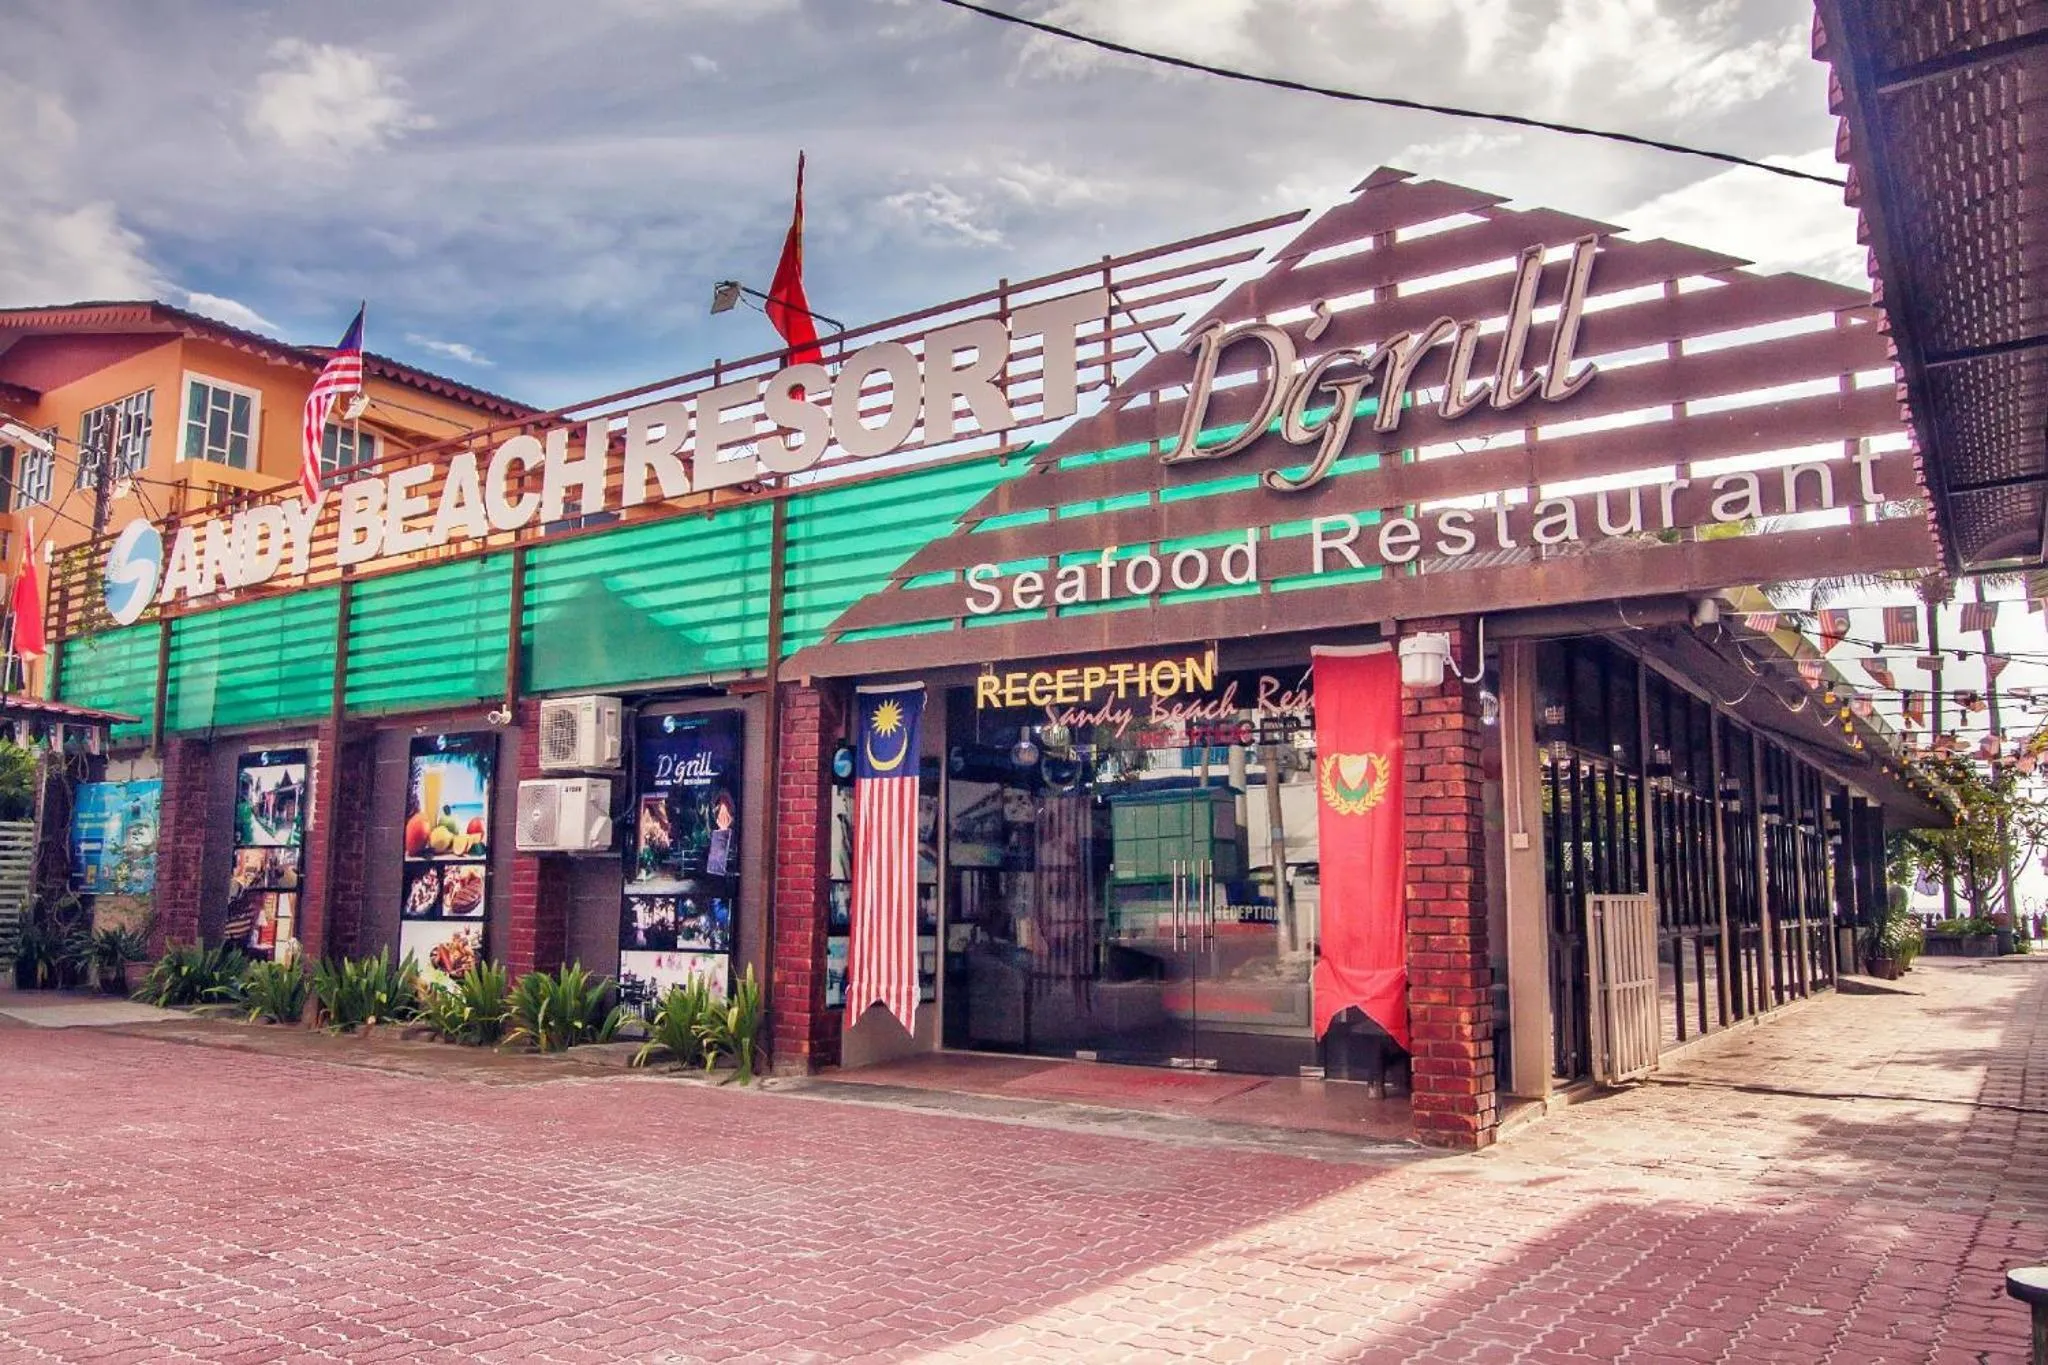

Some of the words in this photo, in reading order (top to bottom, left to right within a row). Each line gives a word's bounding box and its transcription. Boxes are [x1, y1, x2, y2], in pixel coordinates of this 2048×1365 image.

[337, 417, 609, 568] BEACH
[621, 287, 1109, 508] RESORT
[1160, 233, 1598, 491] D'grill
[965, 528, 1258, 615] Seafood
[1312, 438, 1885, 574] Restaurant
[976, 650, 1215, 709] RECEPTION
[1043, 691, 1133, 738] Sandy
[1150, 681, 1238, 724] Beach
[1258, 675, 1315, 713] Res
